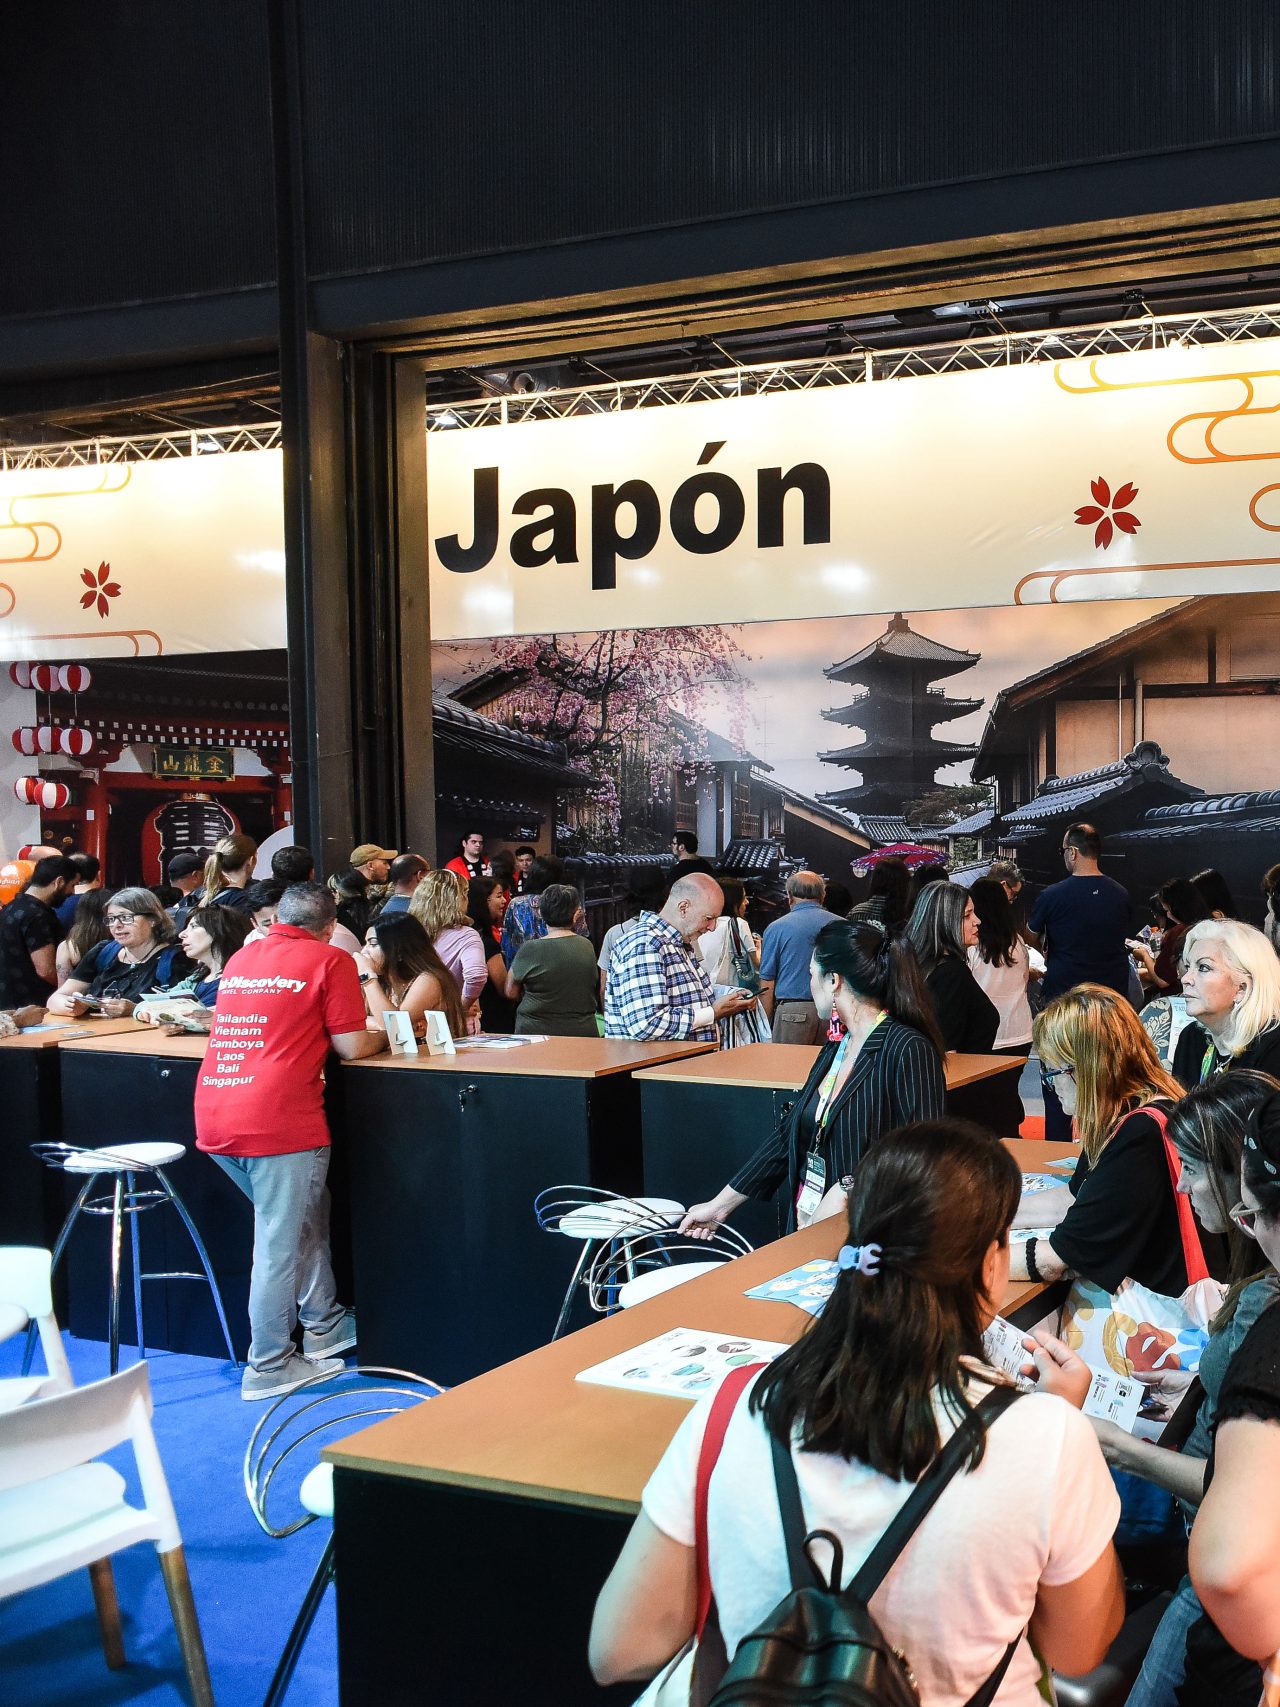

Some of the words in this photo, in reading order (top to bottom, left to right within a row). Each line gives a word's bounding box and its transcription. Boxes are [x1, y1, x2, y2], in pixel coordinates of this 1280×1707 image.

[433, 439, 831, 591] Japón
[241, 987, 283, 995] COMPANY
[216, 1013, 269, 1024] Tailandia
[214, 1026, 262, 1036] Vietnam
[209, 1038, 265, 1051] Camboya
[216, 1051, 246, 1061] Laos
[216, 1063, 240, 1074] Bali
[202, 1075, 256, 1088] Singapur
